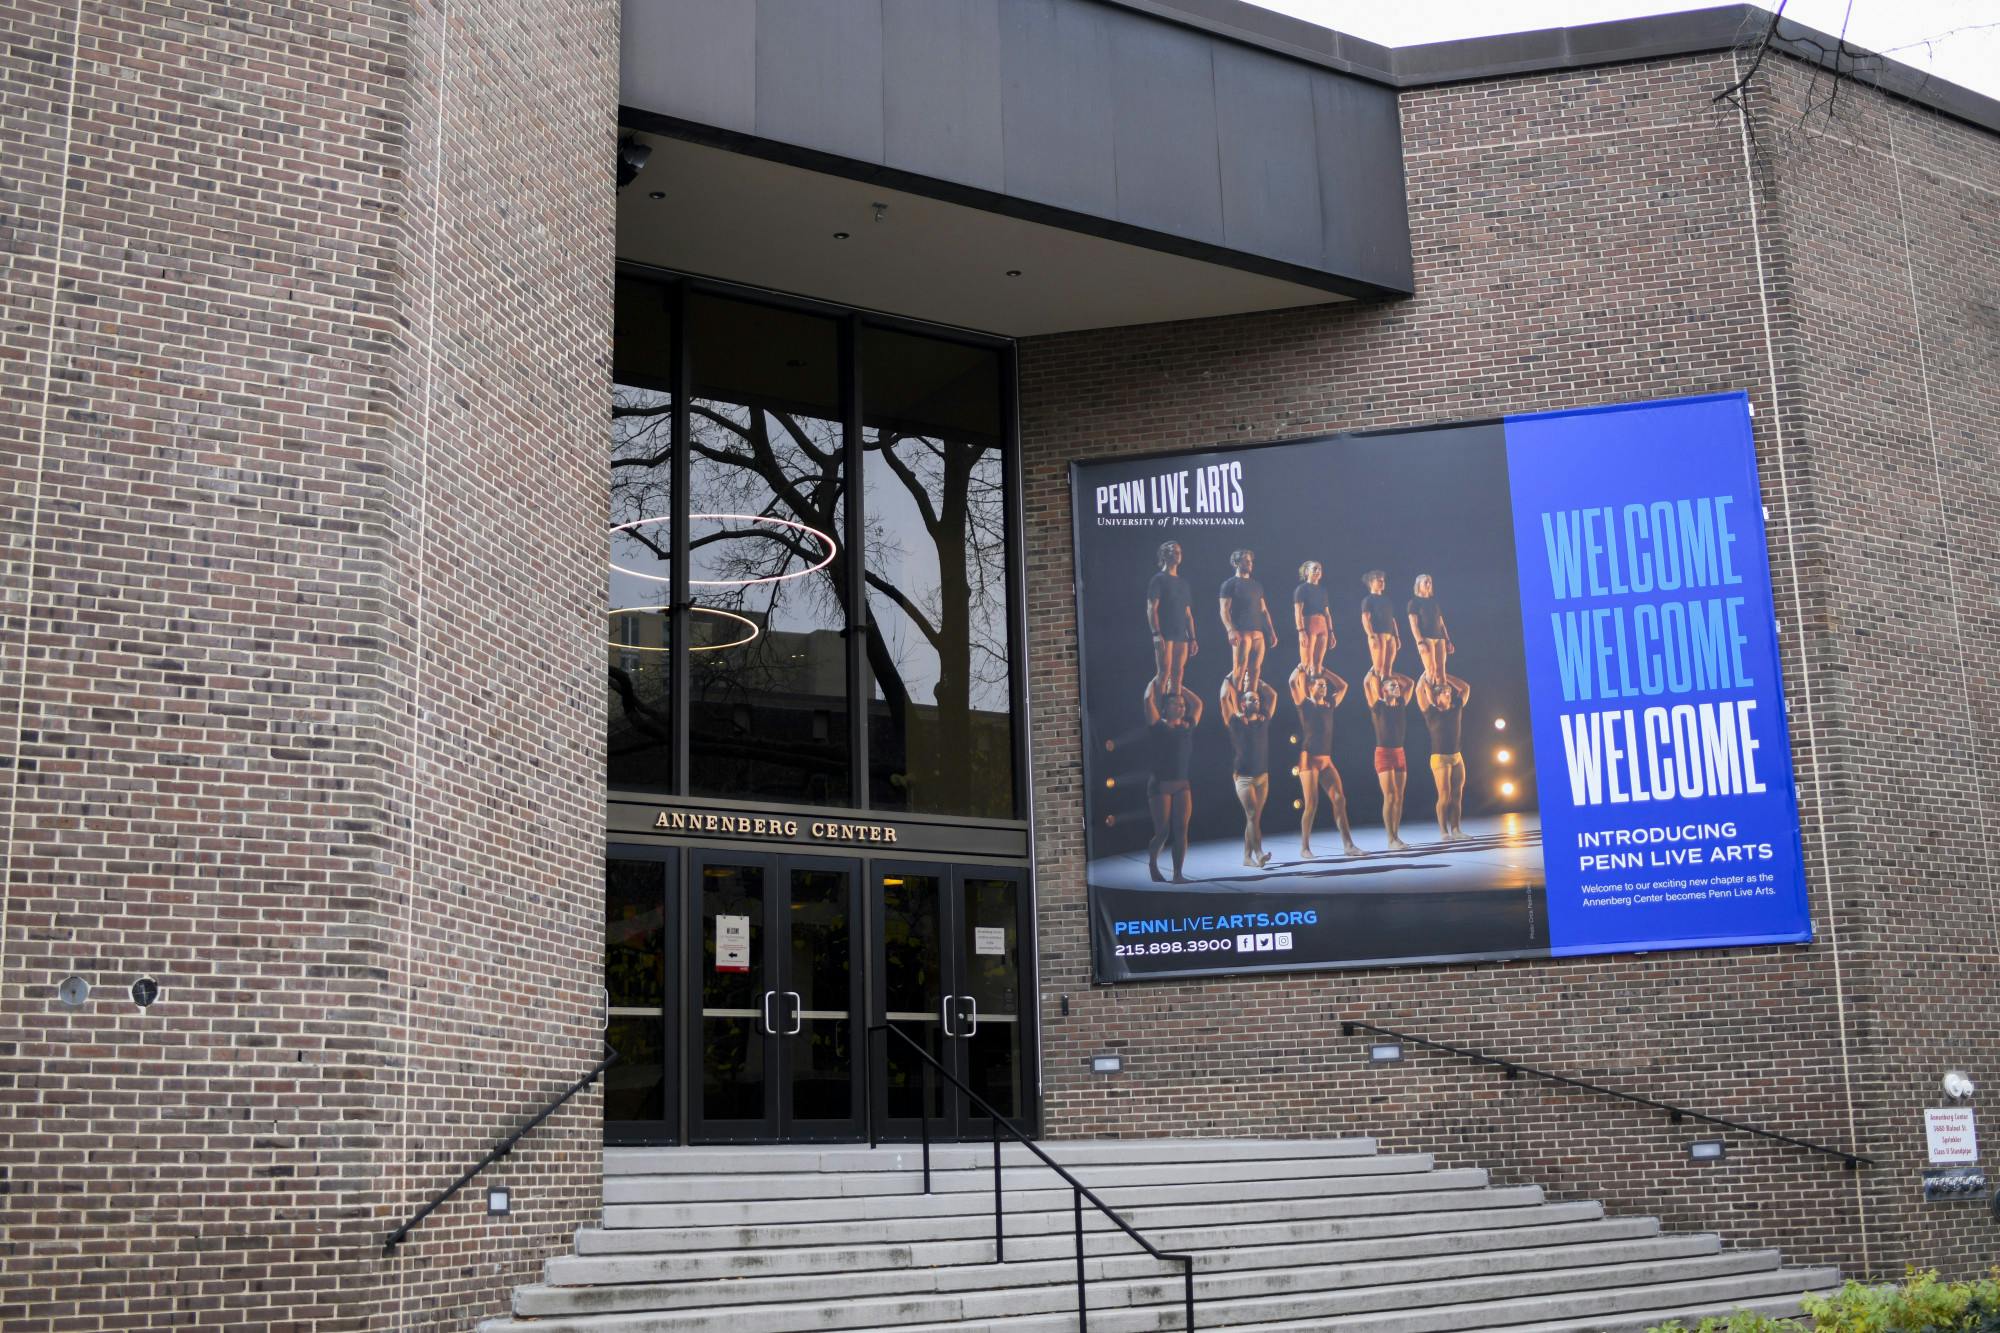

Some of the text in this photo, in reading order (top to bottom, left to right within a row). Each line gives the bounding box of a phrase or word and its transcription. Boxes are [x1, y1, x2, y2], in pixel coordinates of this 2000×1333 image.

[1096, 461, 1244, 514] PENN LIVE ARTS
[1097, 516, 1245, 527] UNIVERSITY of PENNSYLVANIA
[1541, 495, 1743, 600] WELCOME
[1551, 596, 1754, 702] WELCOME
[1560, 699, 1767, 806] WELCOME
[655, 811, 898, 842] ANNENBERG CENTER
[1577, 822, 1738, 848] INTRODUCING
[1579, 843, 1773, 872] PENN LIVE ARTS
[1581, 873, 1774, 894] Welcome to our exciting new chapter as the
[1582, 896, 1632, 907] Annenberg
[1633, 894, 1664, 903] Center
[1665, 891, 1707, 901] becomes
[1708, 889, 1732, 898] Penn
[1734, 887, 1753, 897] Live
[1115, 910, 1318, 936] PENNLIVEARTS.ORG
[1115, 938, 1232, 956] 215.898.3900
